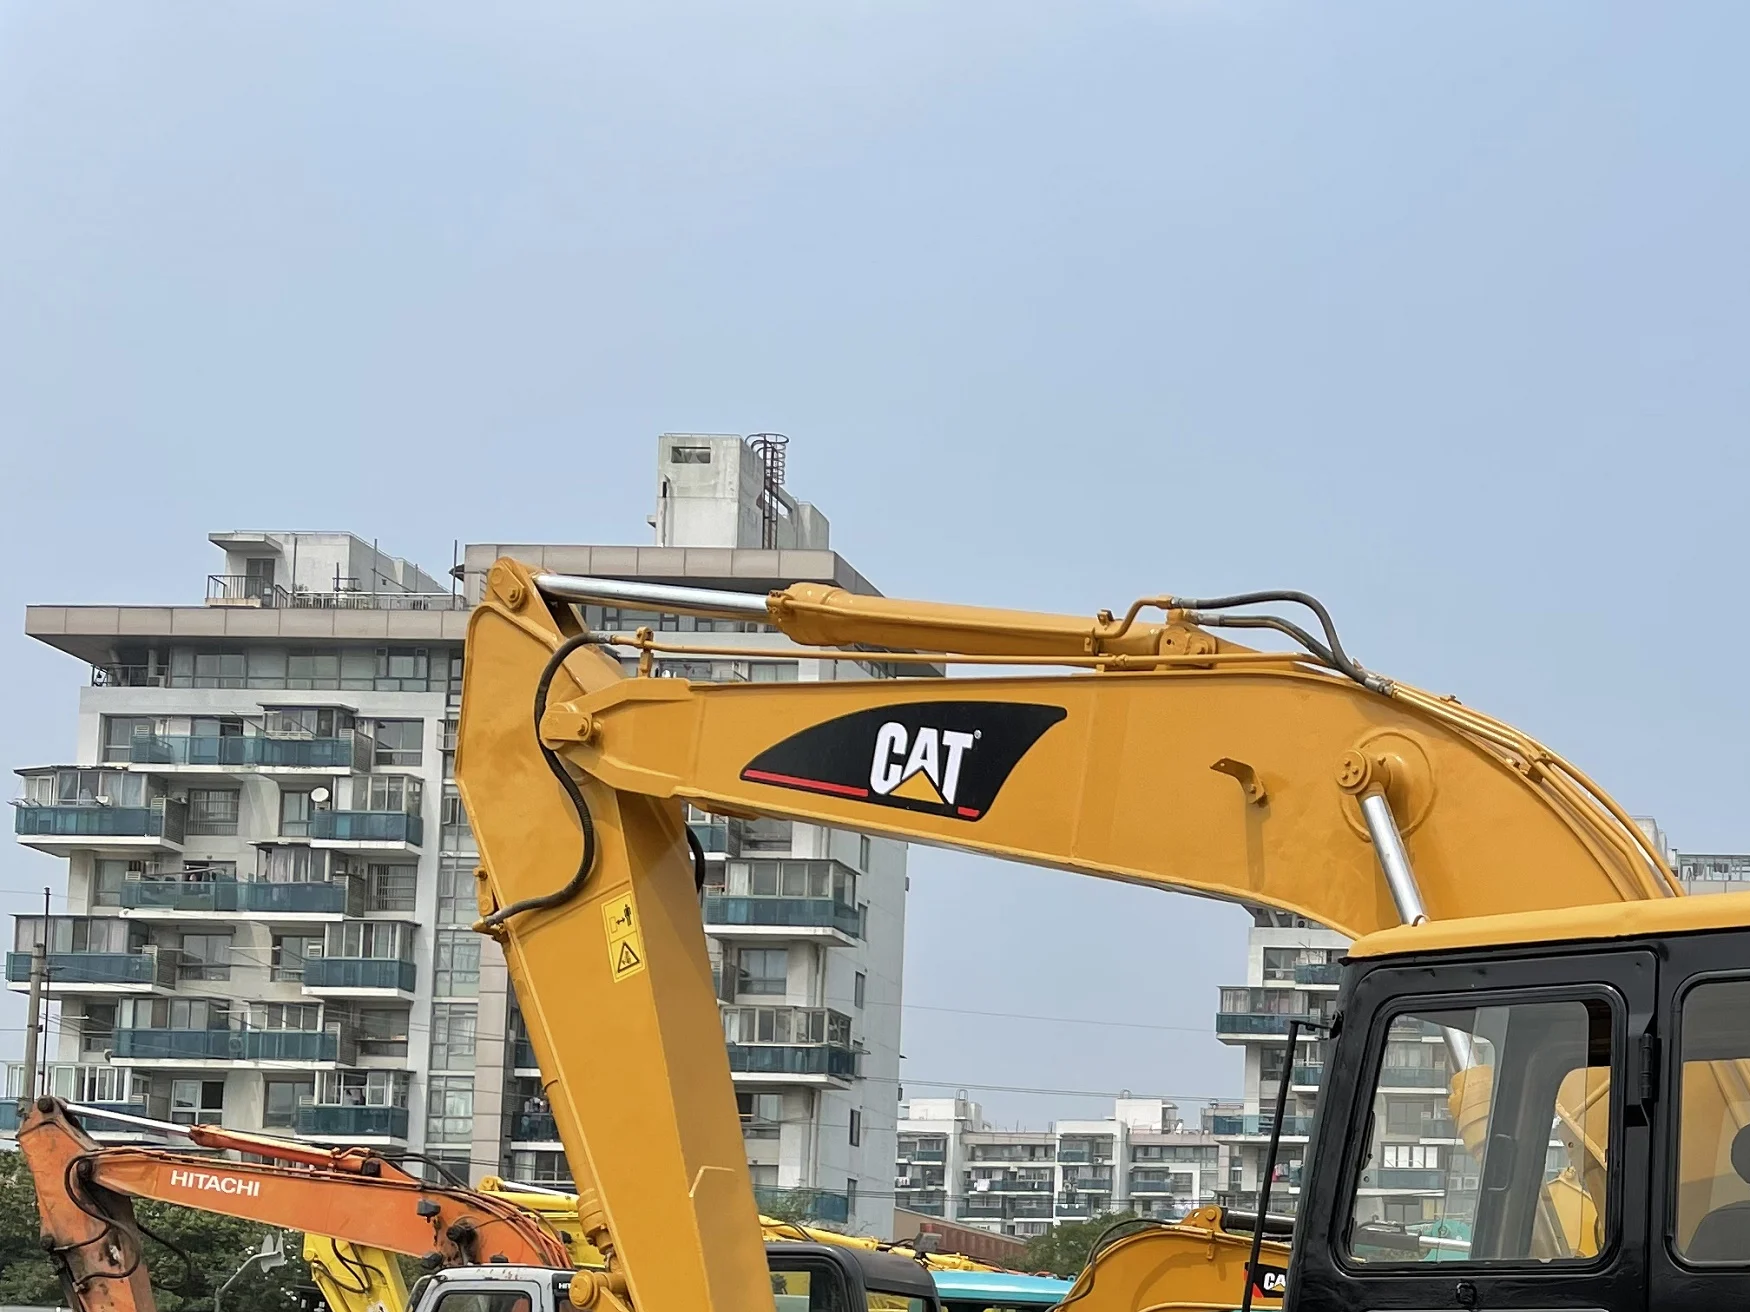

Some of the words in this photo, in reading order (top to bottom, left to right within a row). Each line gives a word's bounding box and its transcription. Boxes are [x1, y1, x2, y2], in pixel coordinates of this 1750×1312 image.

[870, 721, 974, 805] CAT
[170, 1169, 260, 1197] HITACHI
[1263, 1272, 1286, 1290] CA
